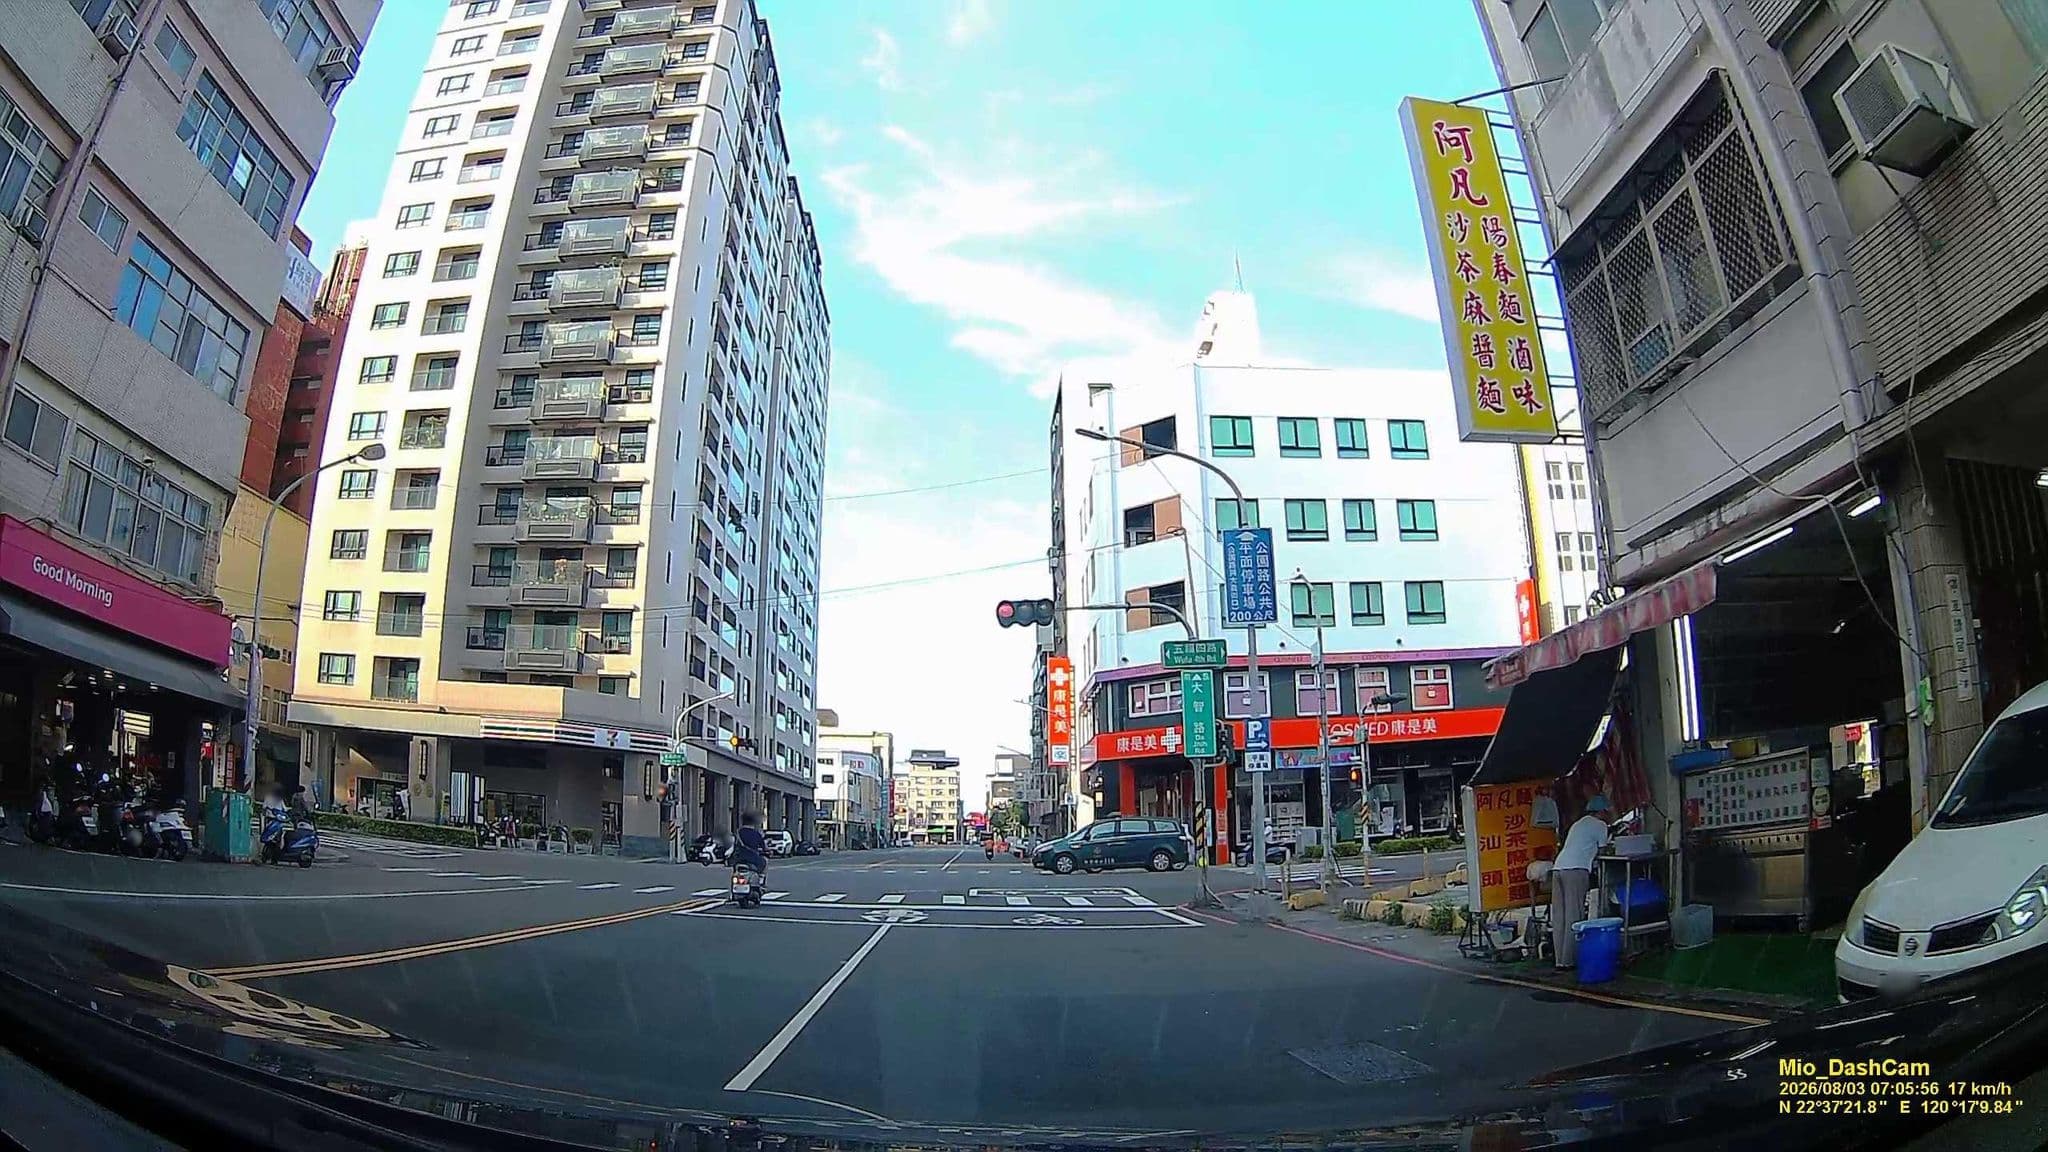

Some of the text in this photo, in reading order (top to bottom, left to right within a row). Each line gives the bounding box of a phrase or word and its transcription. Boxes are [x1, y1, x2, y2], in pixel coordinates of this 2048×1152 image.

[1433, 121, 1489, 207] 阿凡
[1446, 212, 1506, 414] 沙茶麻醬麵
[32, 556, 113, 608] Good Morning
[1053, 689, 1068, 734] 康是美
[1248, 721, 1263, 739] P
[1391, 718, 1437, 735] 康是美
[1117, 734, 1157, 753] 康是美
